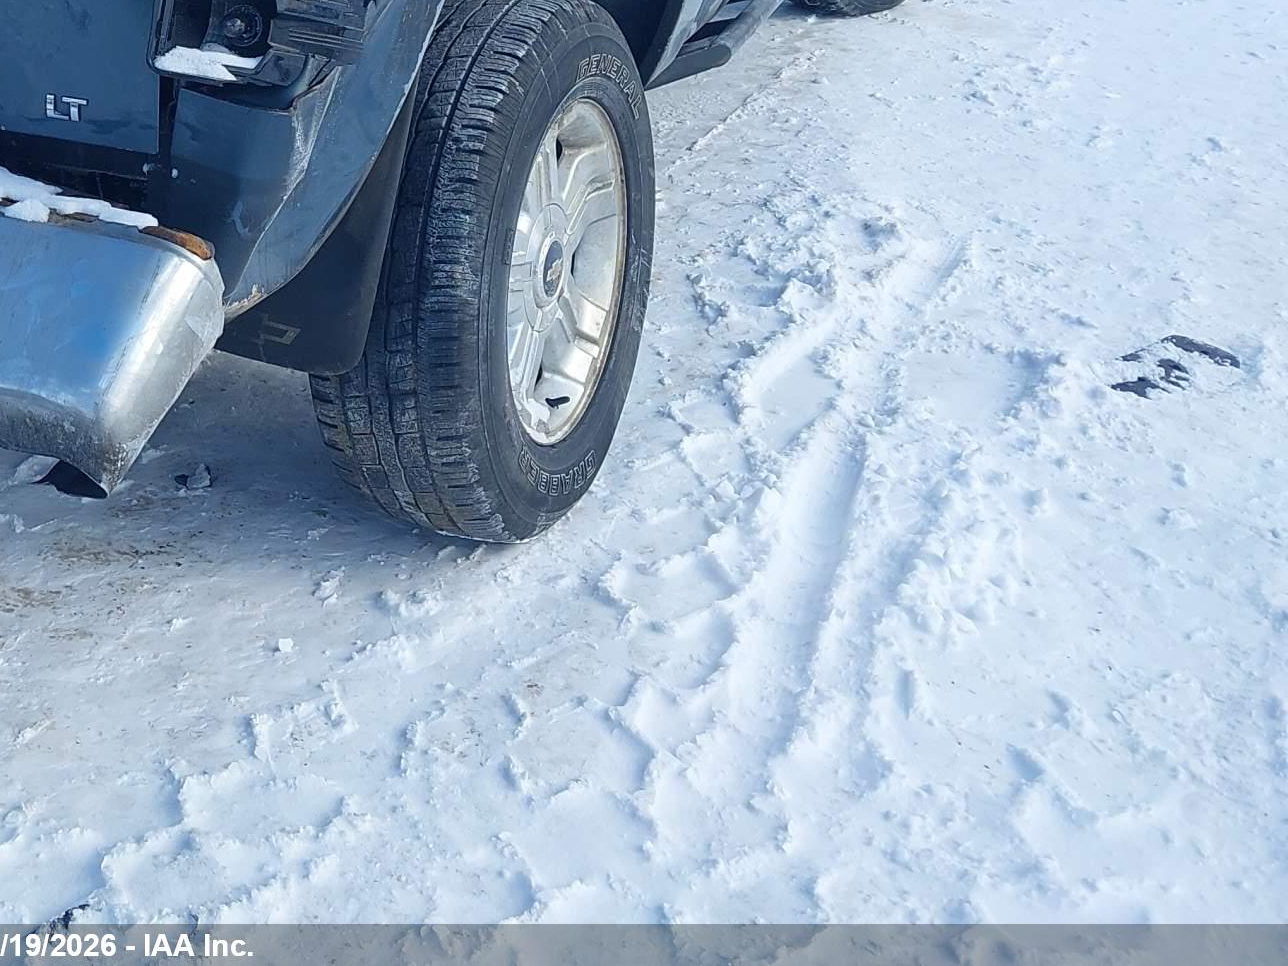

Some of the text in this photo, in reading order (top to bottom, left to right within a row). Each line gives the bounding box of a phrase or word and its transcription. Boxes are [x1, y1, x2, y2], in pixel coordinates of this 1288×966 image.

[46, 94, 88, 122] LT
[576, 53, 642, 120] GENERAL
[518, 446, 597, 496] GRABBER
